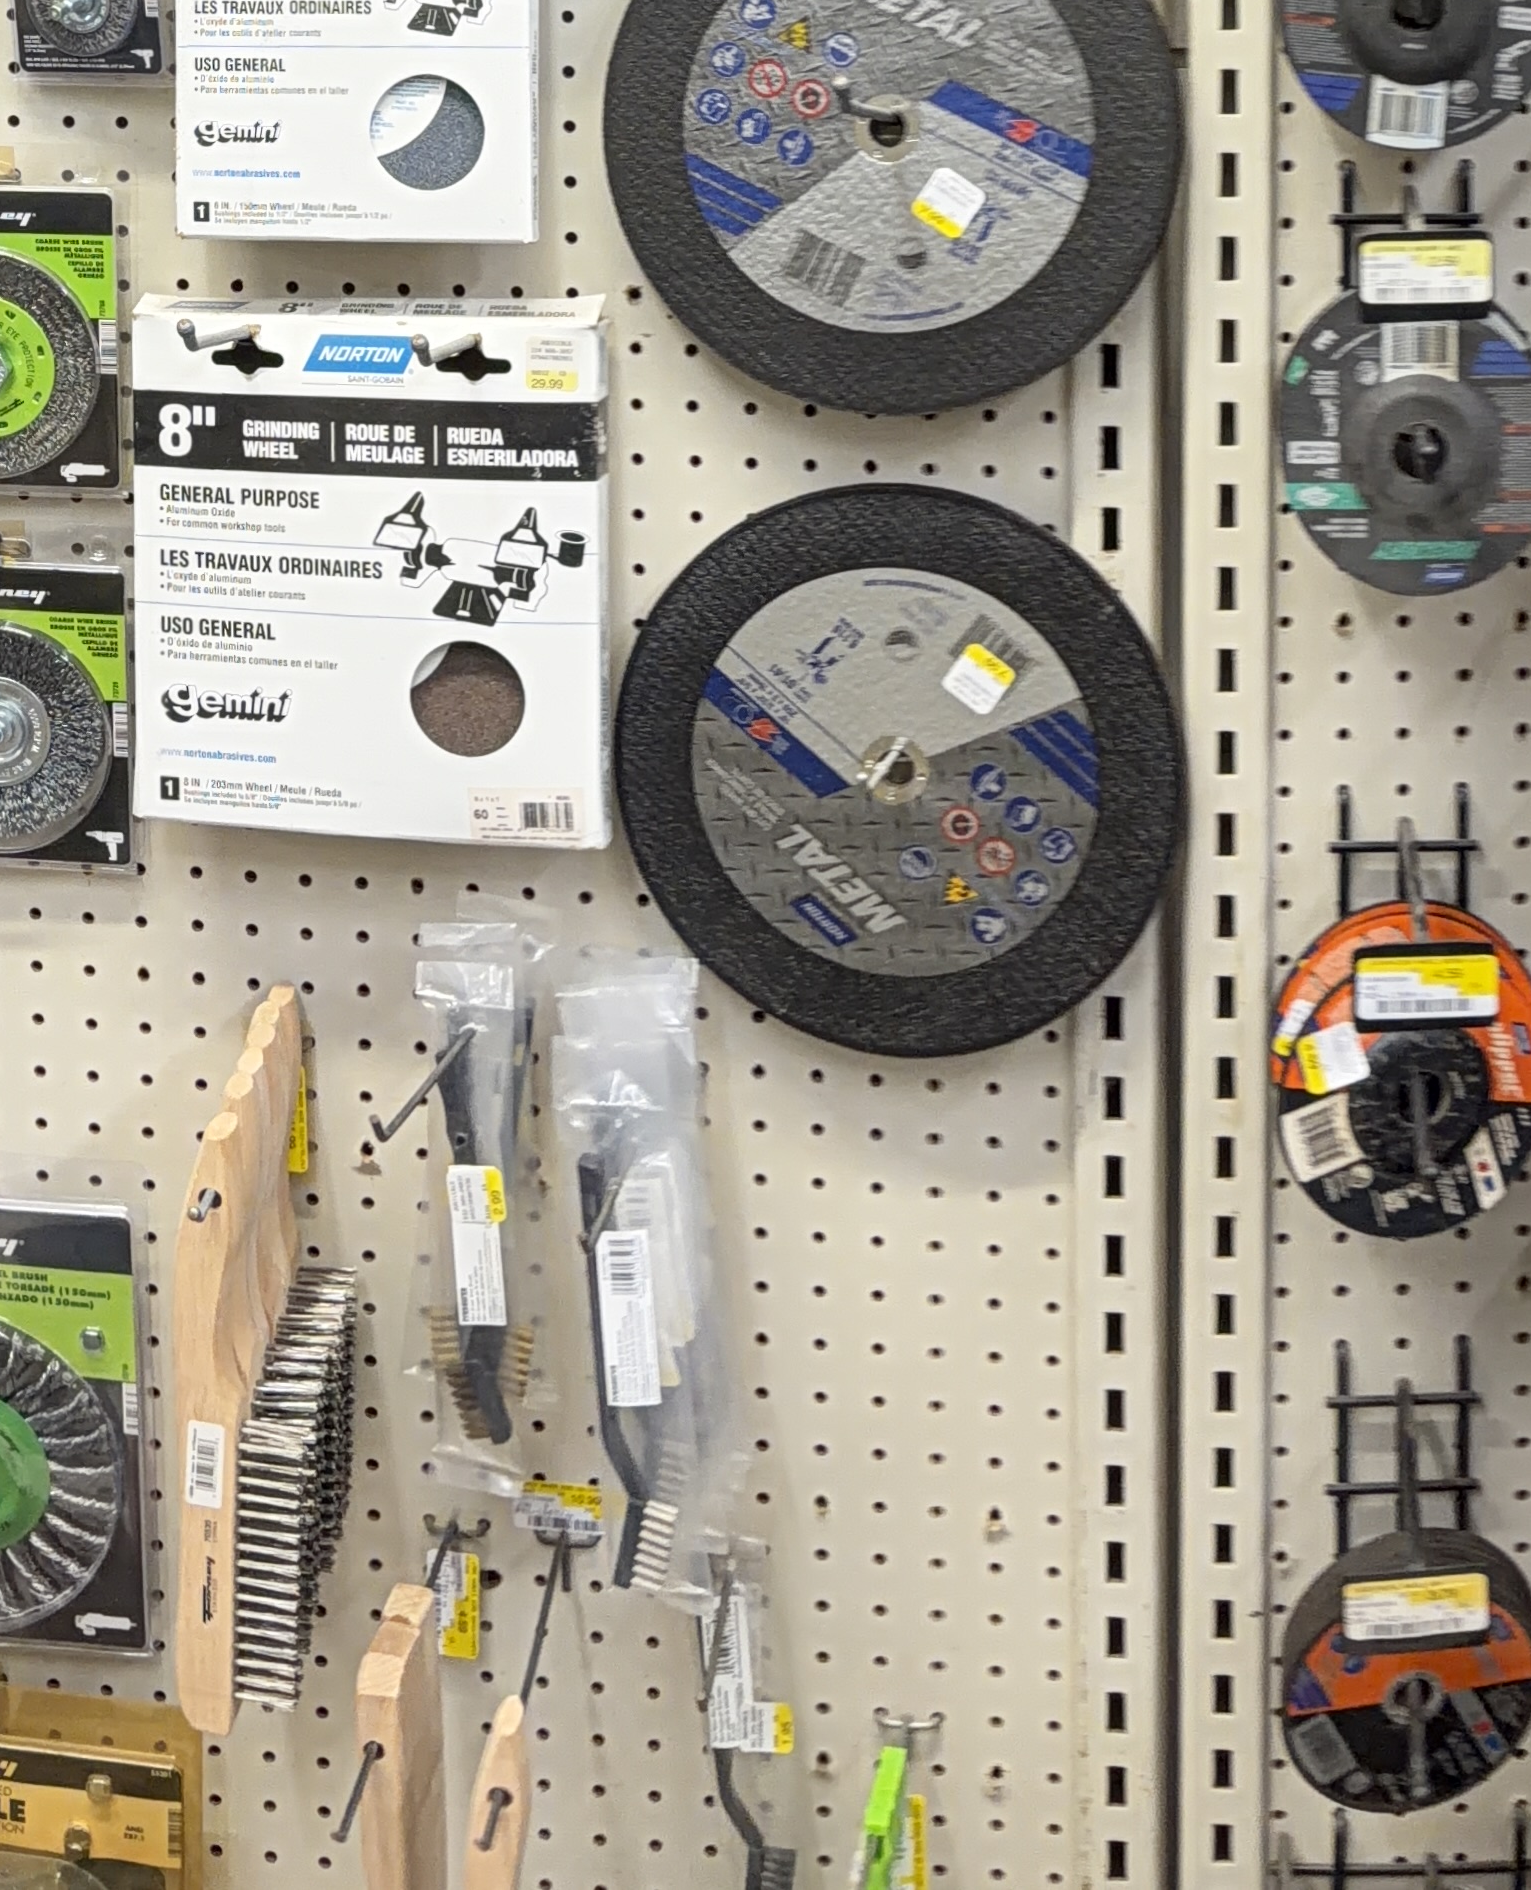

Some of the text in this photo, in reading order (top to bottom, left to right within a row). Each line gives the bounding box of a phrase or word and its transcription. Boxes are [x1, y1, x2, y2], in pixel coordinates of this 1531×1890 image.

[194, 0, 372, 15] LES TRAVAUX ORDINAIRES
[194, 58, 286, 72] USO GENERAL
[193, 119, 282, 146] gemini
[317, 345, 405, 363] NORTON
[530, 378, 564, 389] 29.99
[158, 403, 504, 457] 8" GRINDING ROUE DE RUEDA
[243, 441, 579, 468] WHEEL MEULAGE ESMERILADORA
[159, 483, 320, 509] GENERAL PURPOSE
[160, 548, 383, 579] LES TRAVAUX ORDINAIRES
[160, 616, 276, 641] USO GENERAL
[162, 683, 293, 723] gemini
[771, 824, 906, 934] METAL
